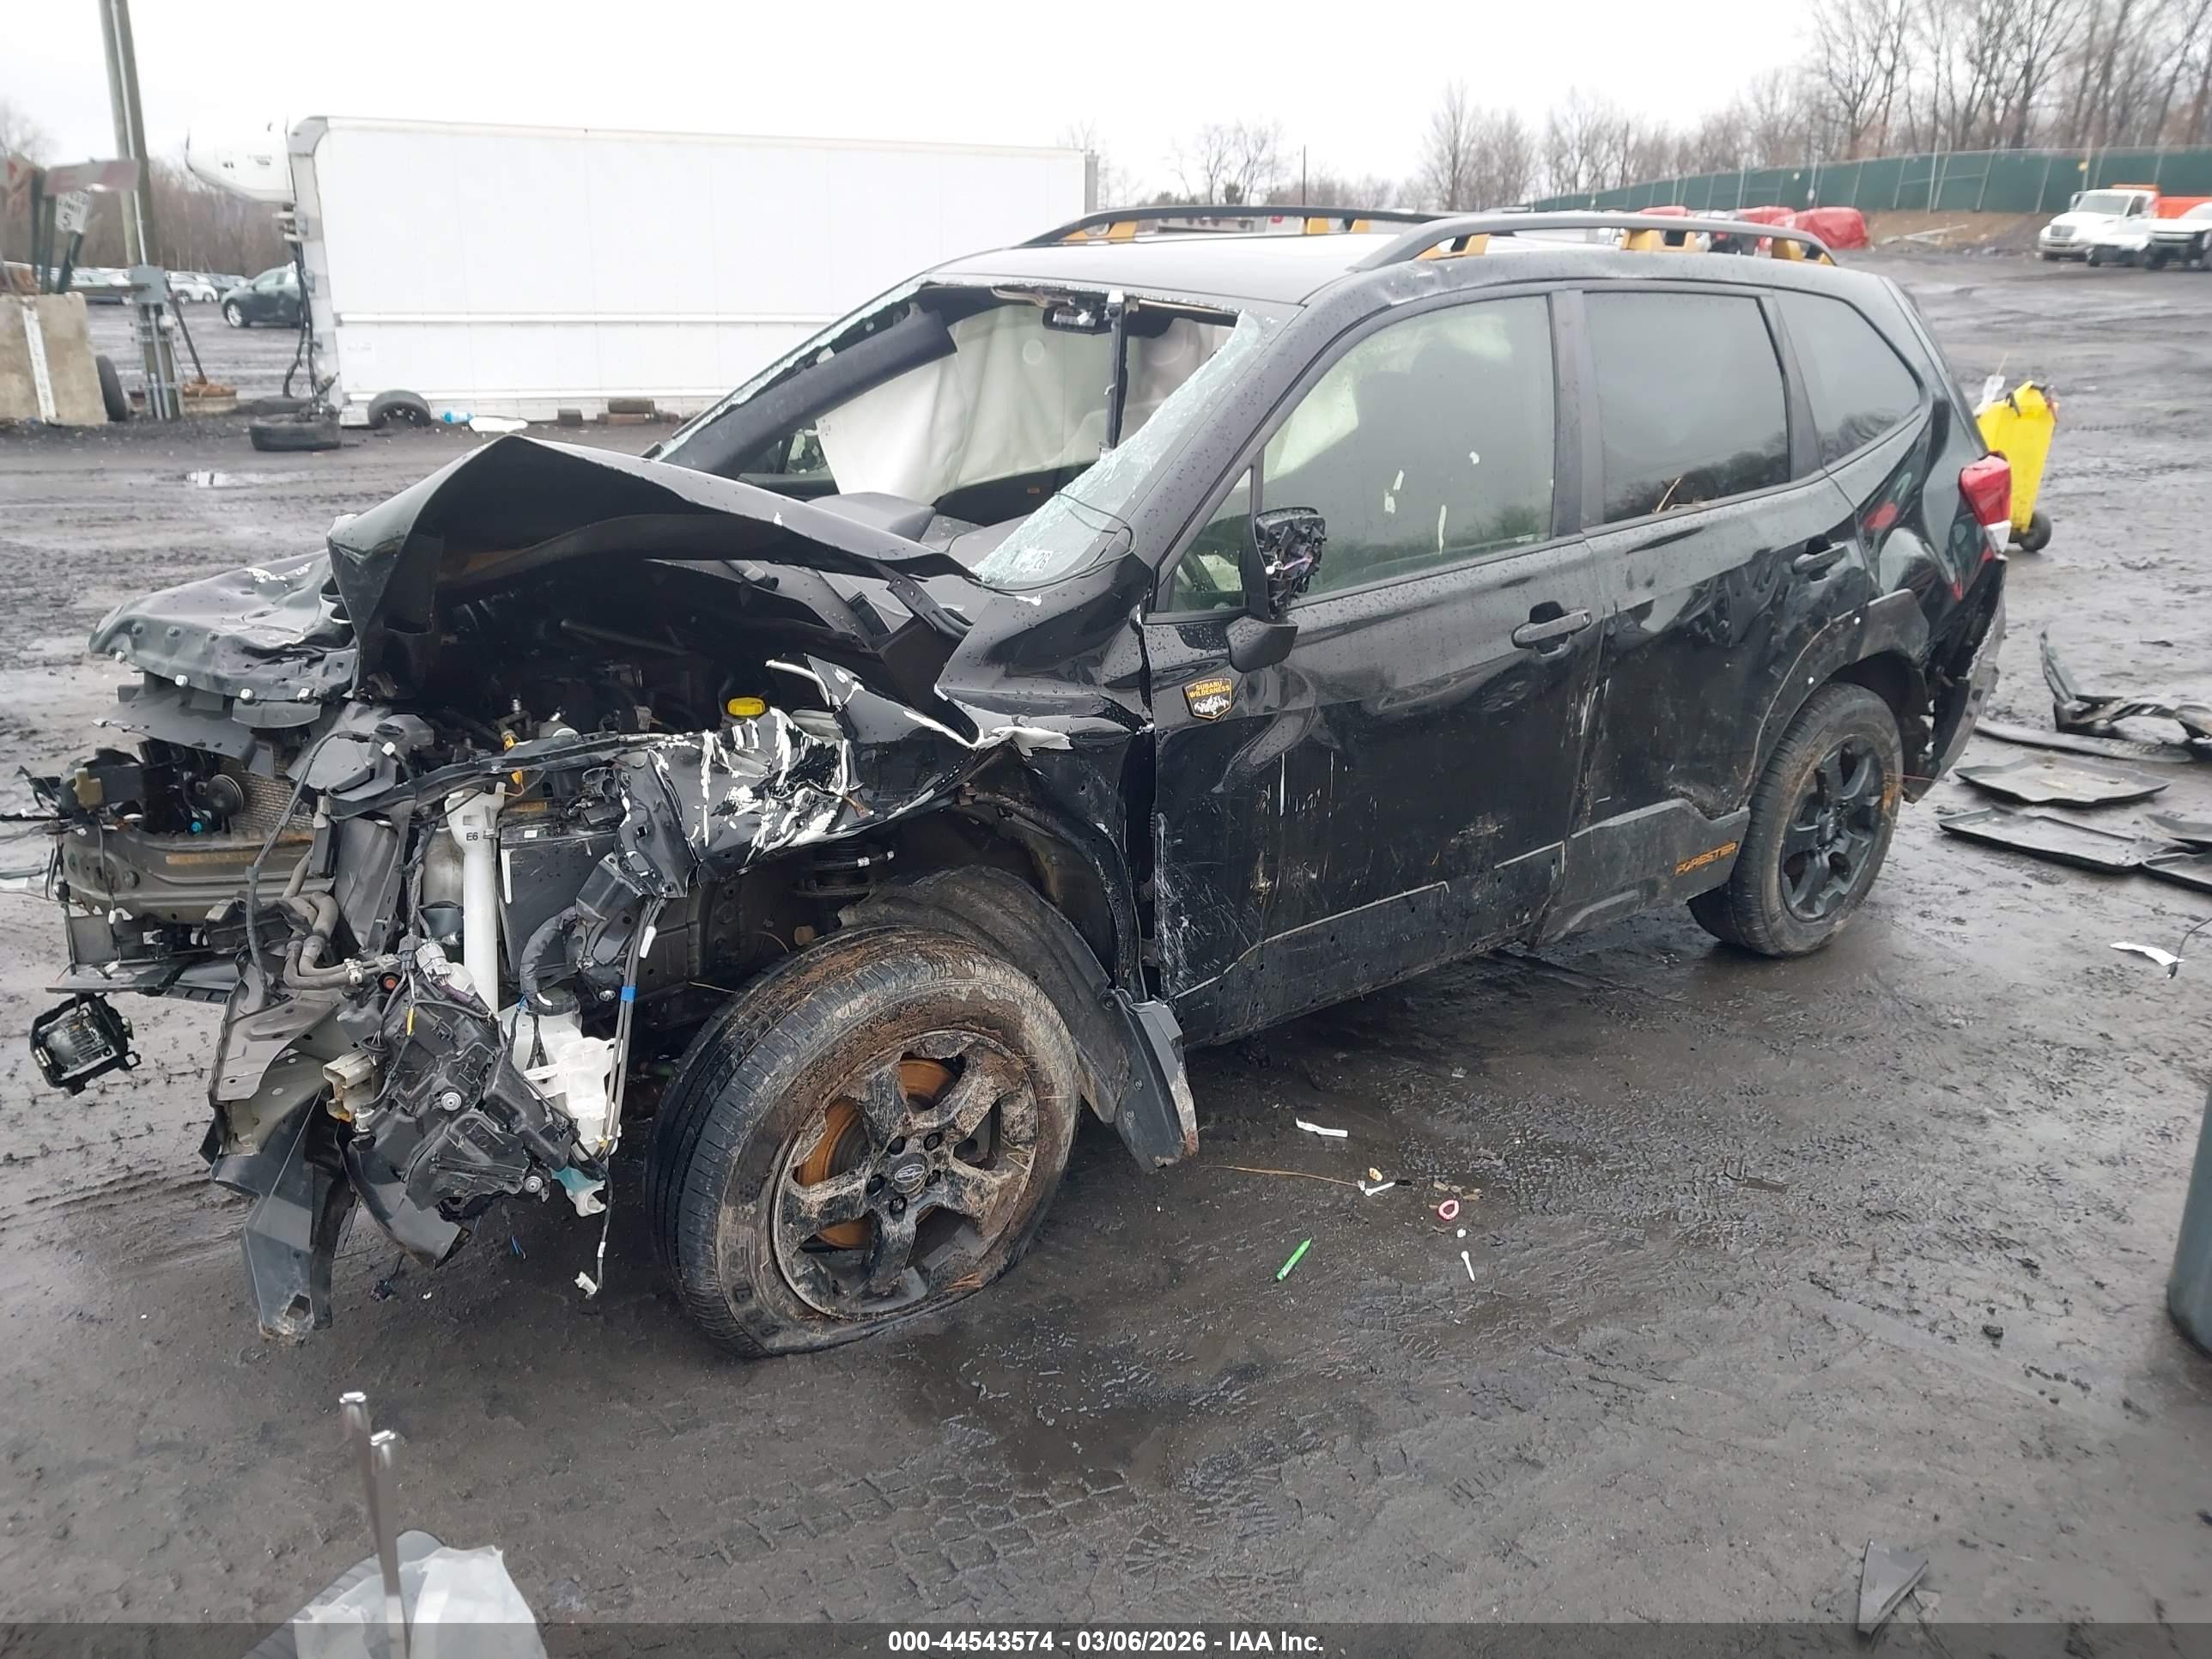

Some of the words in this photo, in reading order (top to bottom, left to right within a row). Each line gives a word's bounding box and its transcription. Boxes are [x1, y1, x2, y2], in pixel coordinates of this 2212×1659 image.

[1189, 684, 1231, 698] WILDERNESS
[1195, 681, 1223, 691] SUBARU
[465, 831, 479, 842] E6
[1674, 842, 1738, 877] FORESTER
